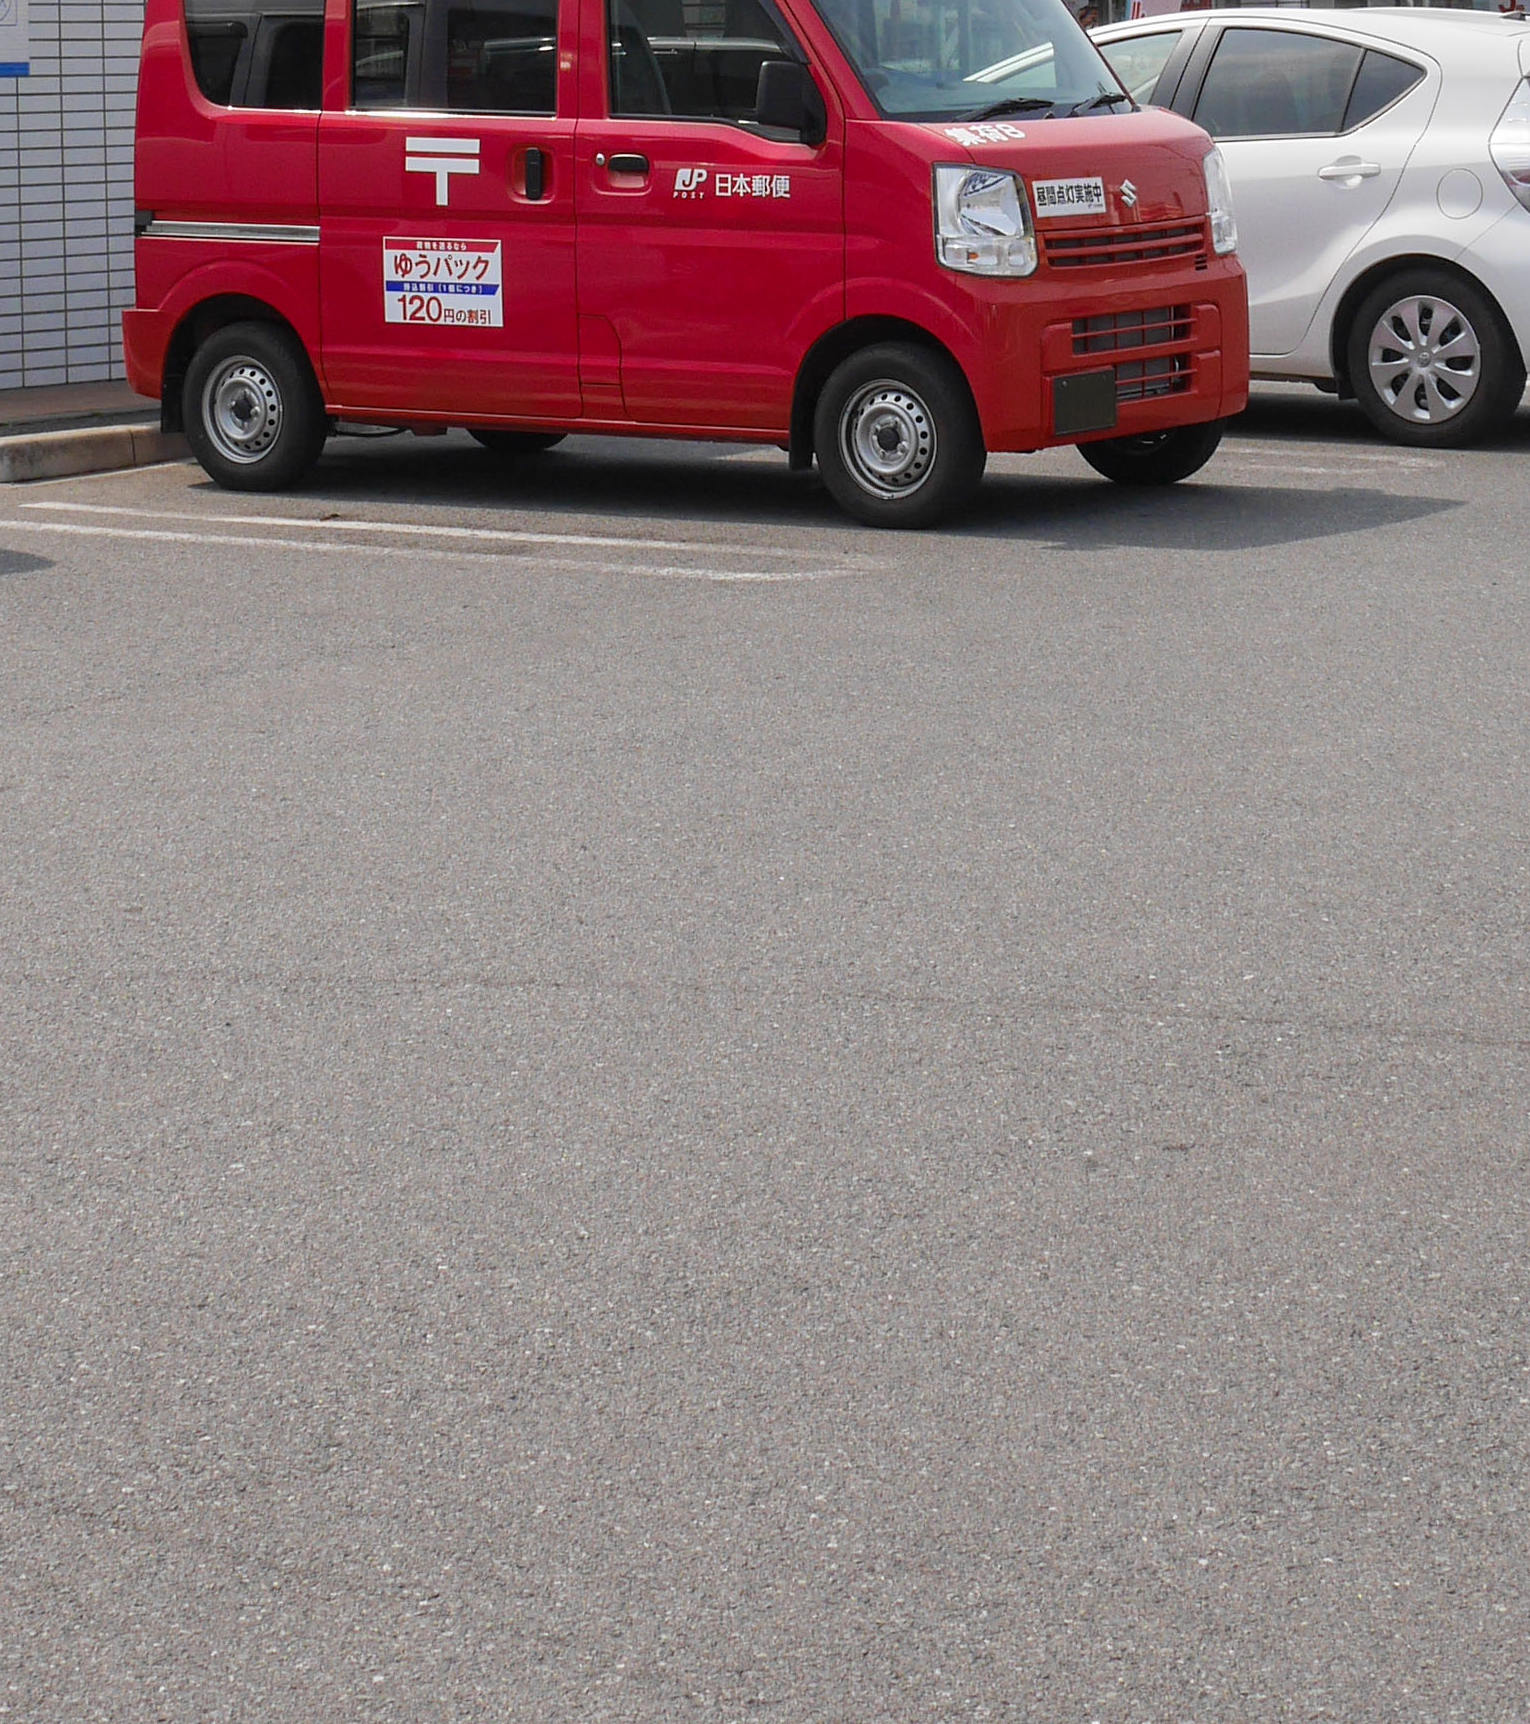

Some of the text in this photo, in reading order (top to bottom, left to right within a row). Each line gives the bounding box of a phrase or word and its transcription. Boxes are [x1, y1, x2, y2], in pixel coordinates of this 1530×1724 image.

[715, 173, 791, 198] 日本郵便
[394, 253, 489, 281] ゆうパック
